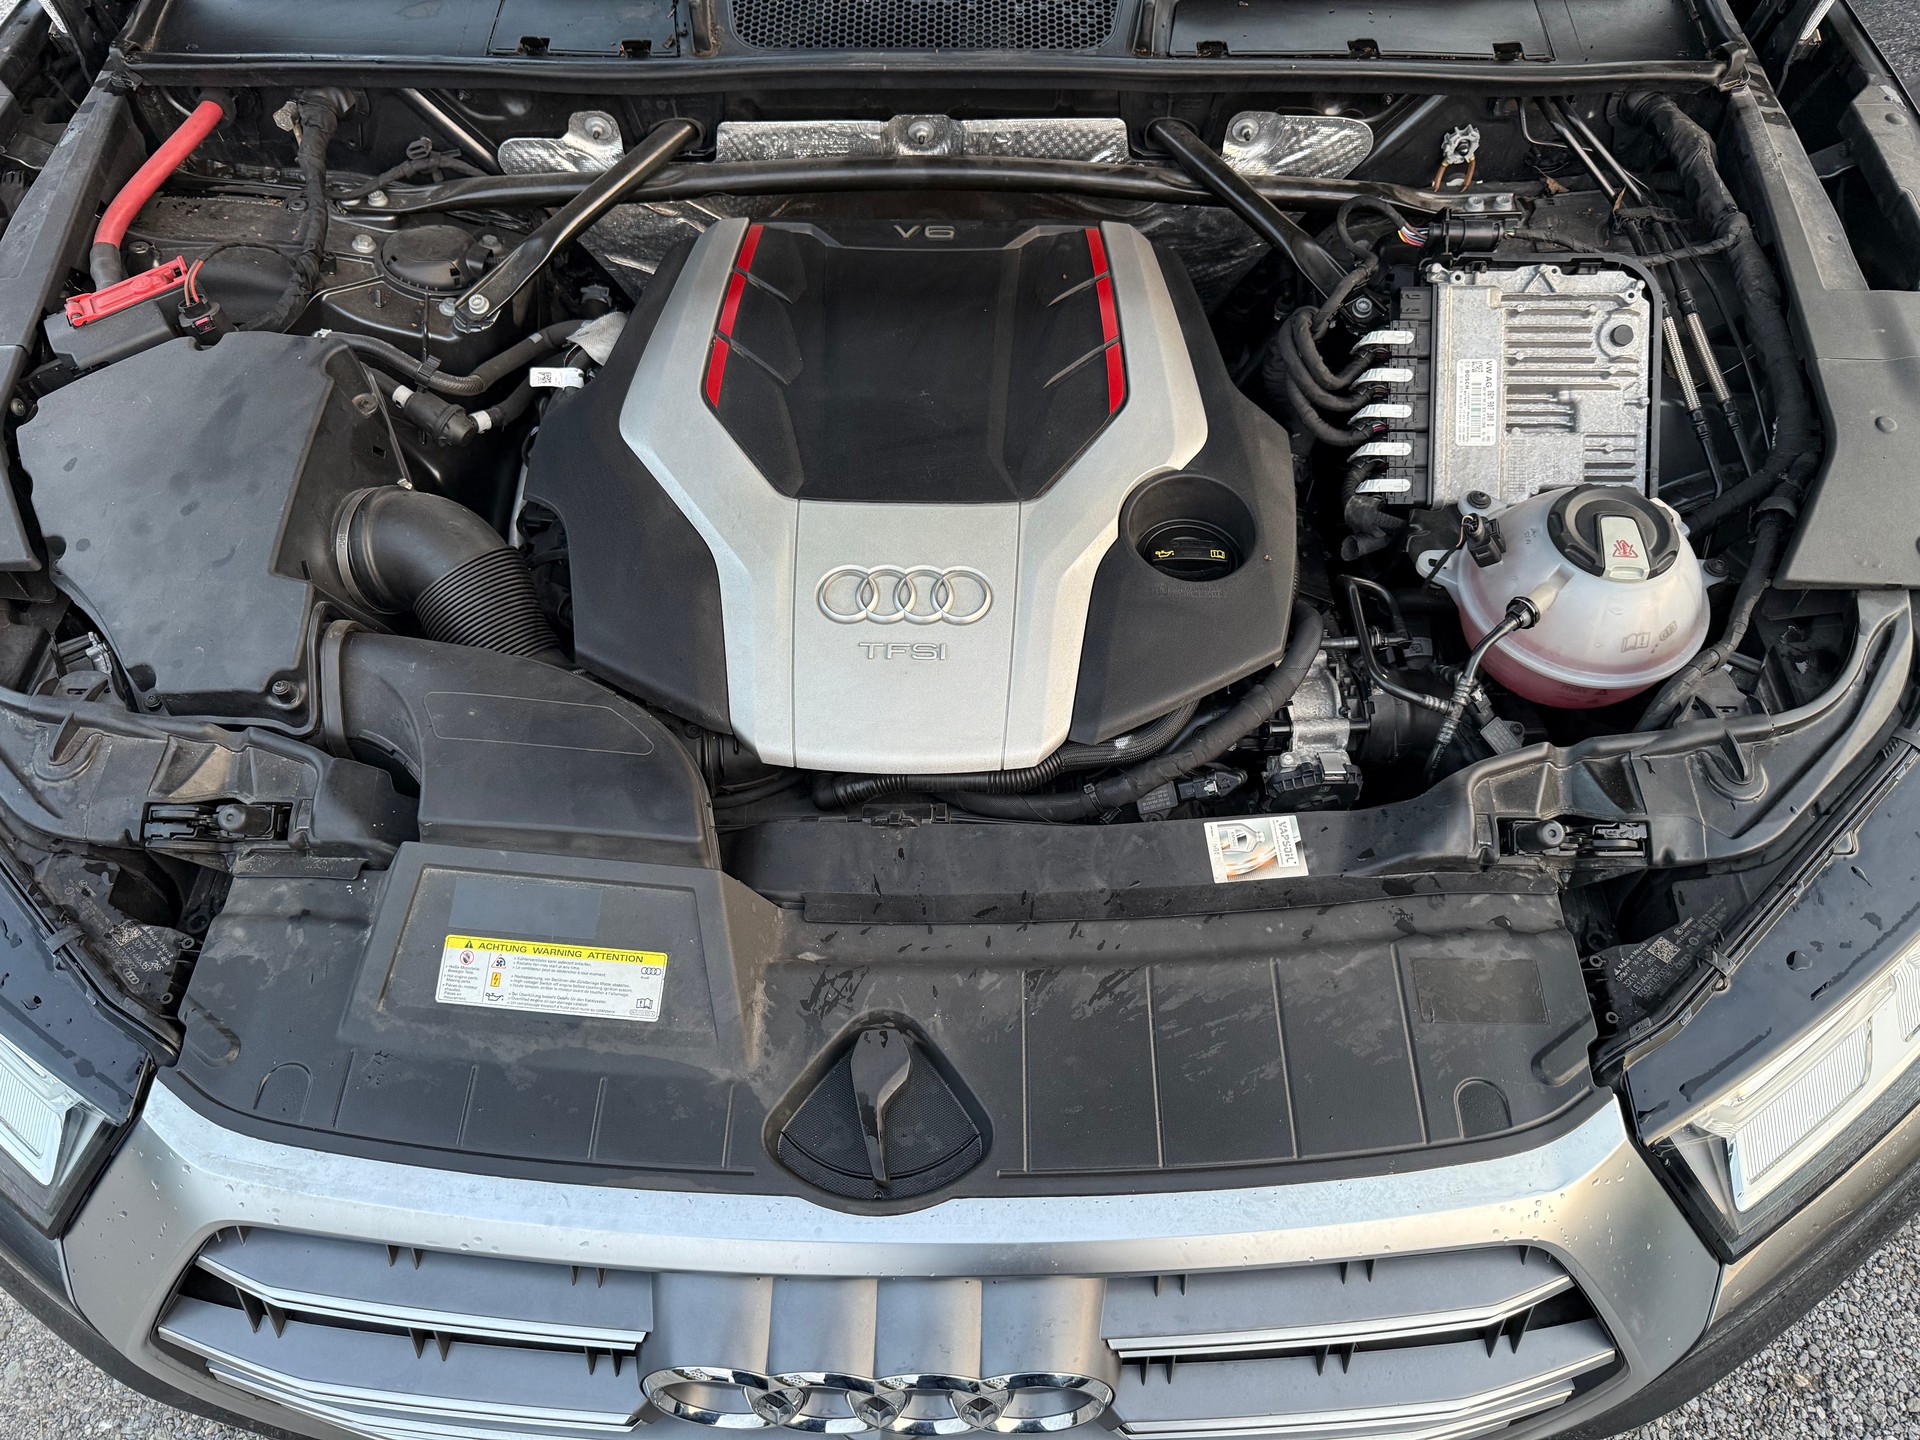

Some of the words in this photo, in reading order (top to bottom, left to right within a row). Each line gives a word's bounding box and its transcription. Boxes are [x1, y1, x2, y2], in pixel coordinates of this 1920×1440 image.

[893, 225, 956, 240] V6
[858, 642, 946, 660] TFSI
[478, 942, 527, 953] ACHTUNG
[532, 946, 582, 958] WARNING
[587, 951, 644, 963] ATTENTION
